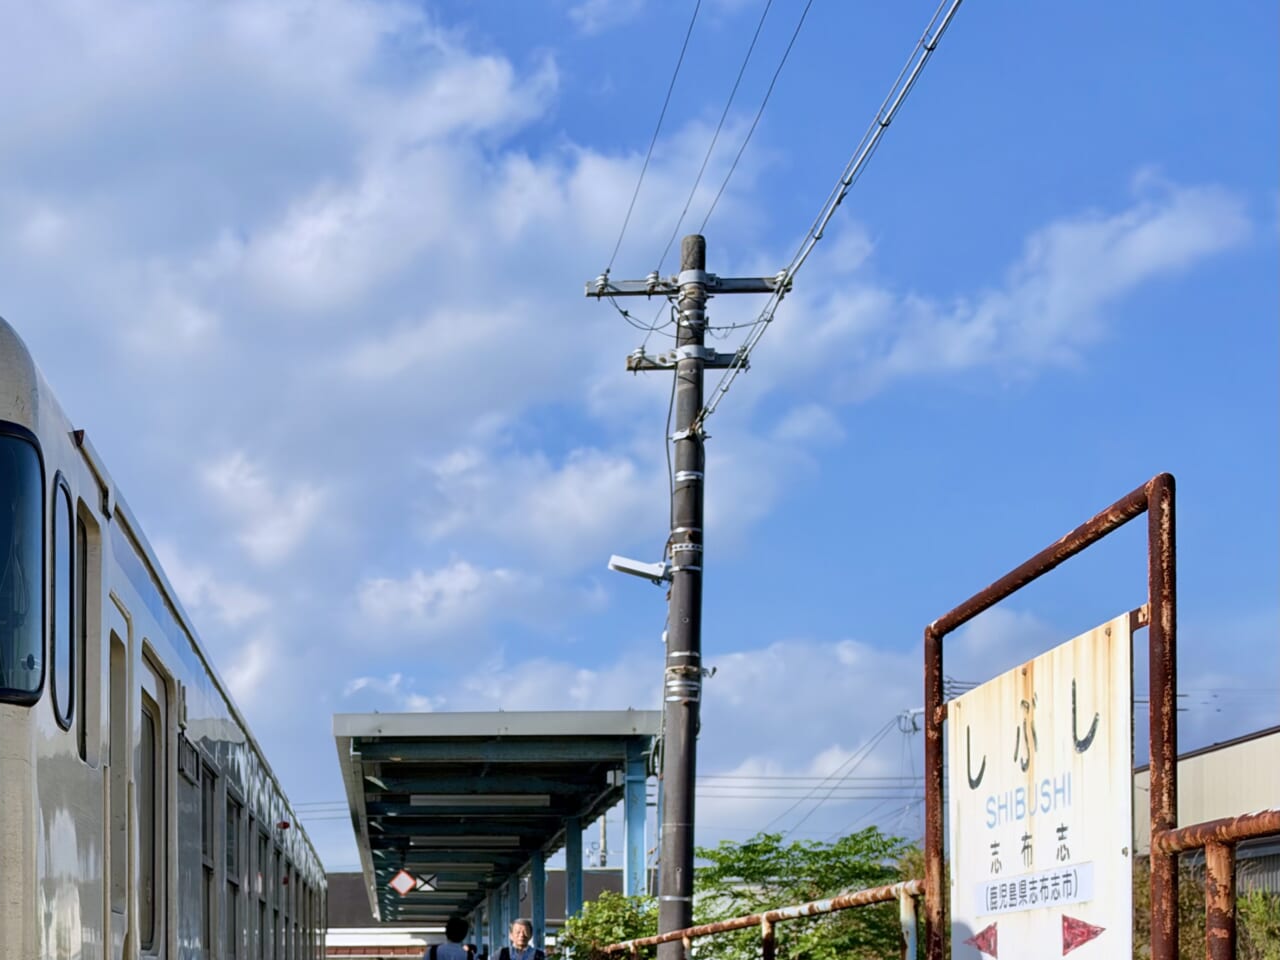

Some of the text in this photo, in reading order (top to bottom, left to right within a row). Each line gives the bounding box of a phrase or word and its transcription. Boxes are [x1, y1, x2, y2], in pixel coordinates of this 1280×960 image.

[966, 677, 1099, 790] しぶし
[985, 772, 1072, 829] SHIBUSHI
[989, 822, 1071, 874] 志布志
